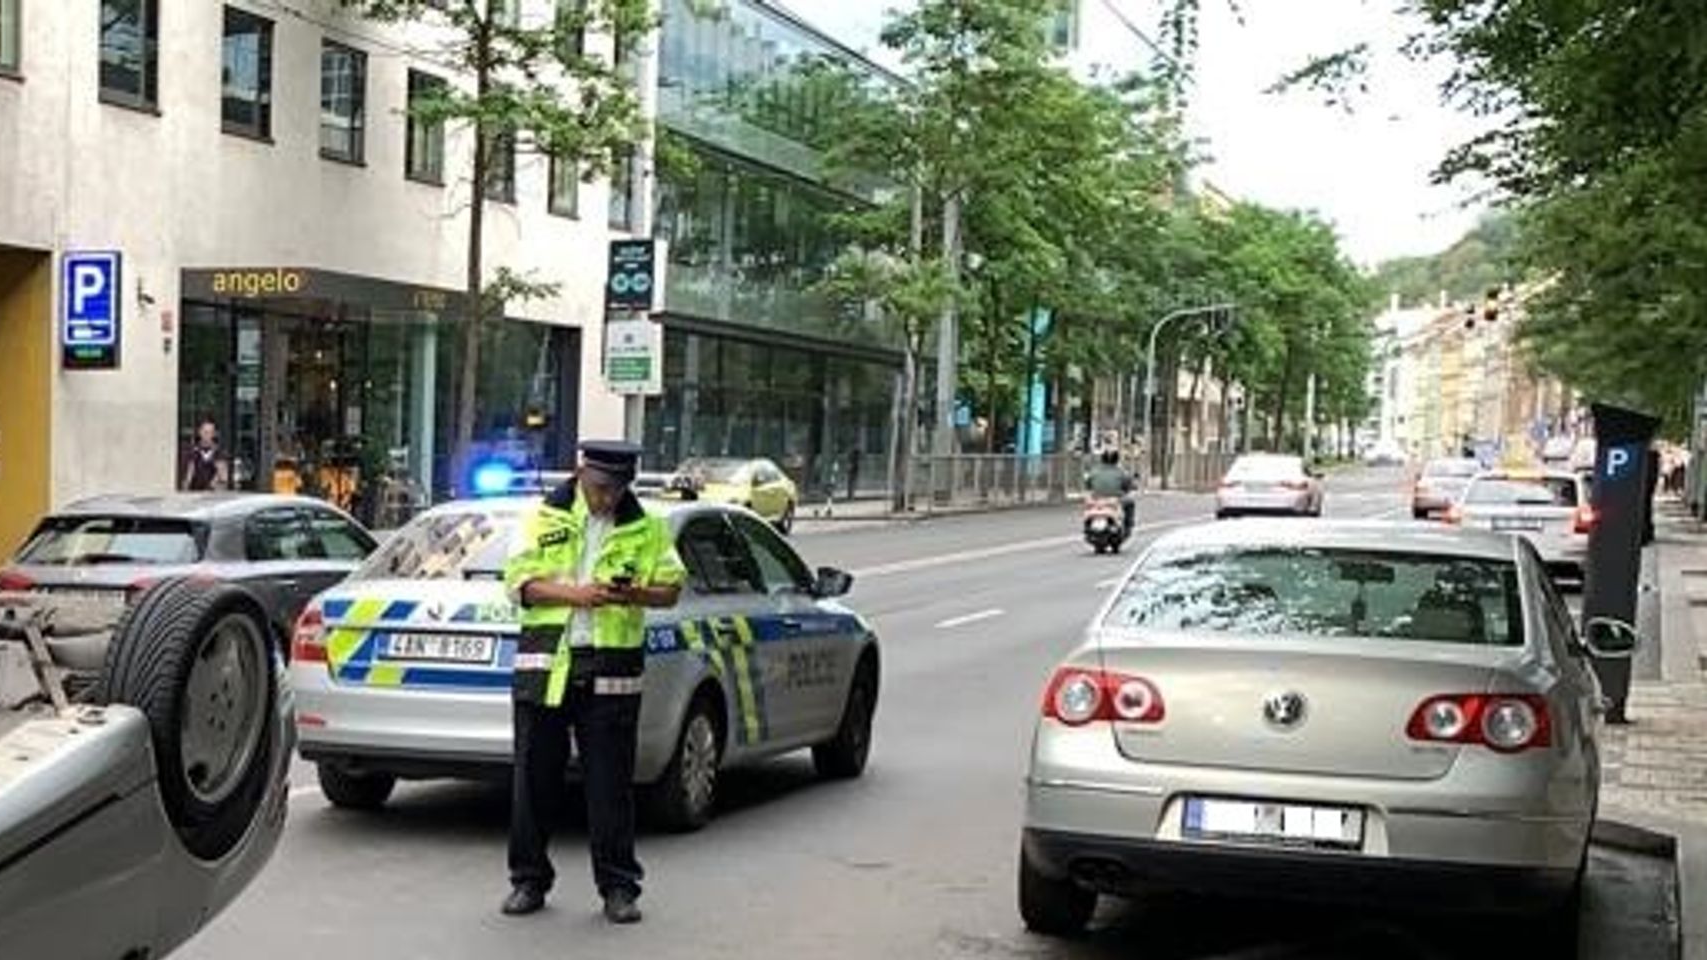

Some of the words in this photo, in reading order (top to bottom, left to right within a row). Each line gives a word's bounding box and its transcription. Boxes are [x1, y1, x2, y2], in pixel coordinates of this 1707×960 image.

[74, 265, 106, 314] P
[213, 268, 301, 298] angelo
[1606, 447, 1629, 475] P
